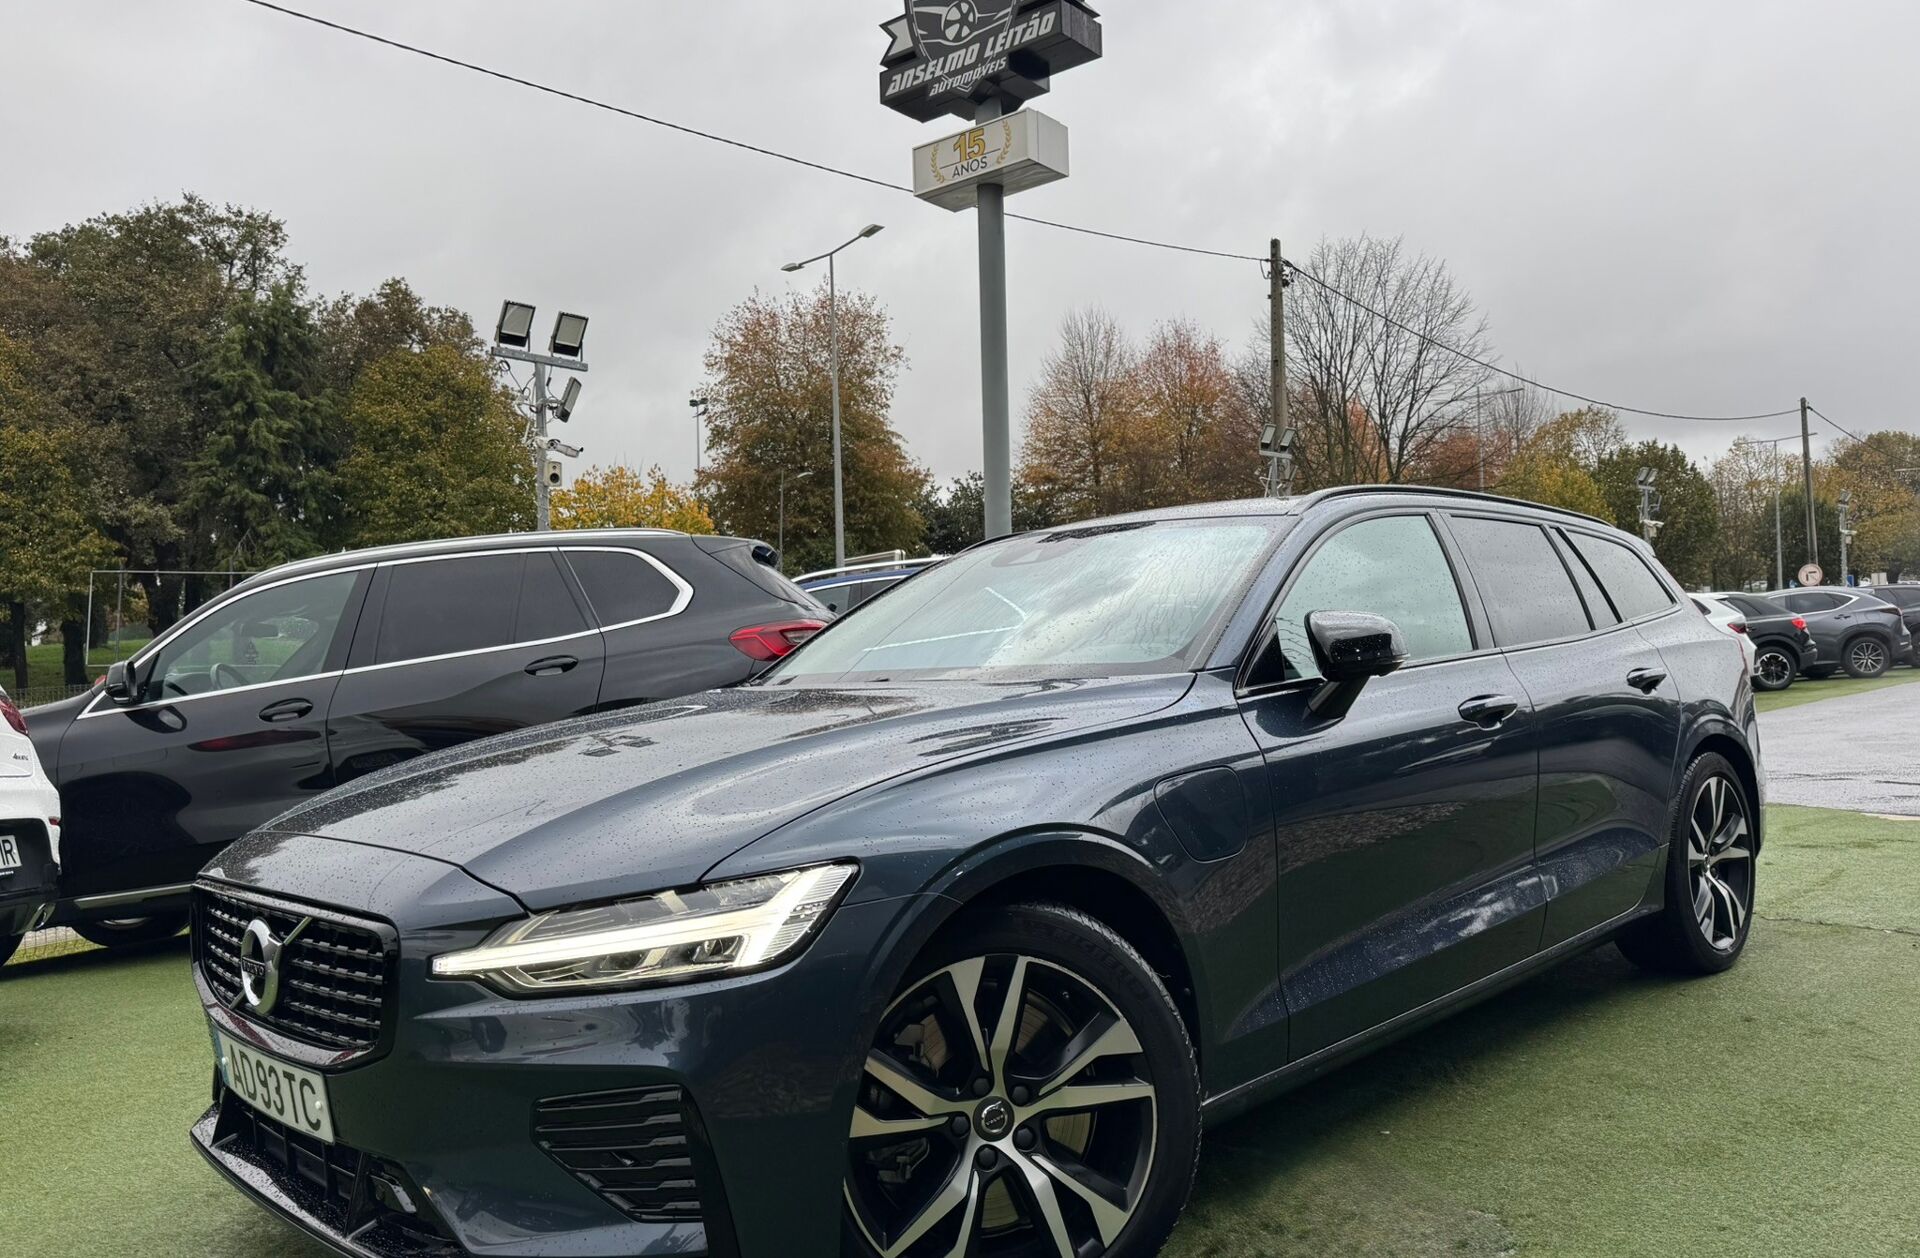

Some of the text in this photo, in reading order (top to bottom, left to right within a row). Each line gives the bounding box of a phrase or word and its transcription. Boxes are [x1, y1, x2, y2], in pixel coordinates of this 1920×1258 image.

[885, 11, 1057, 97] ANSELMO LEITÃO
[929, 56, 1007, 97] AUTOMÓVEIS
[953, 127, 986, 163] 15
[952, 155, 988, 179] ANOS
[230, 1043, 322, 1132] AD93TC
